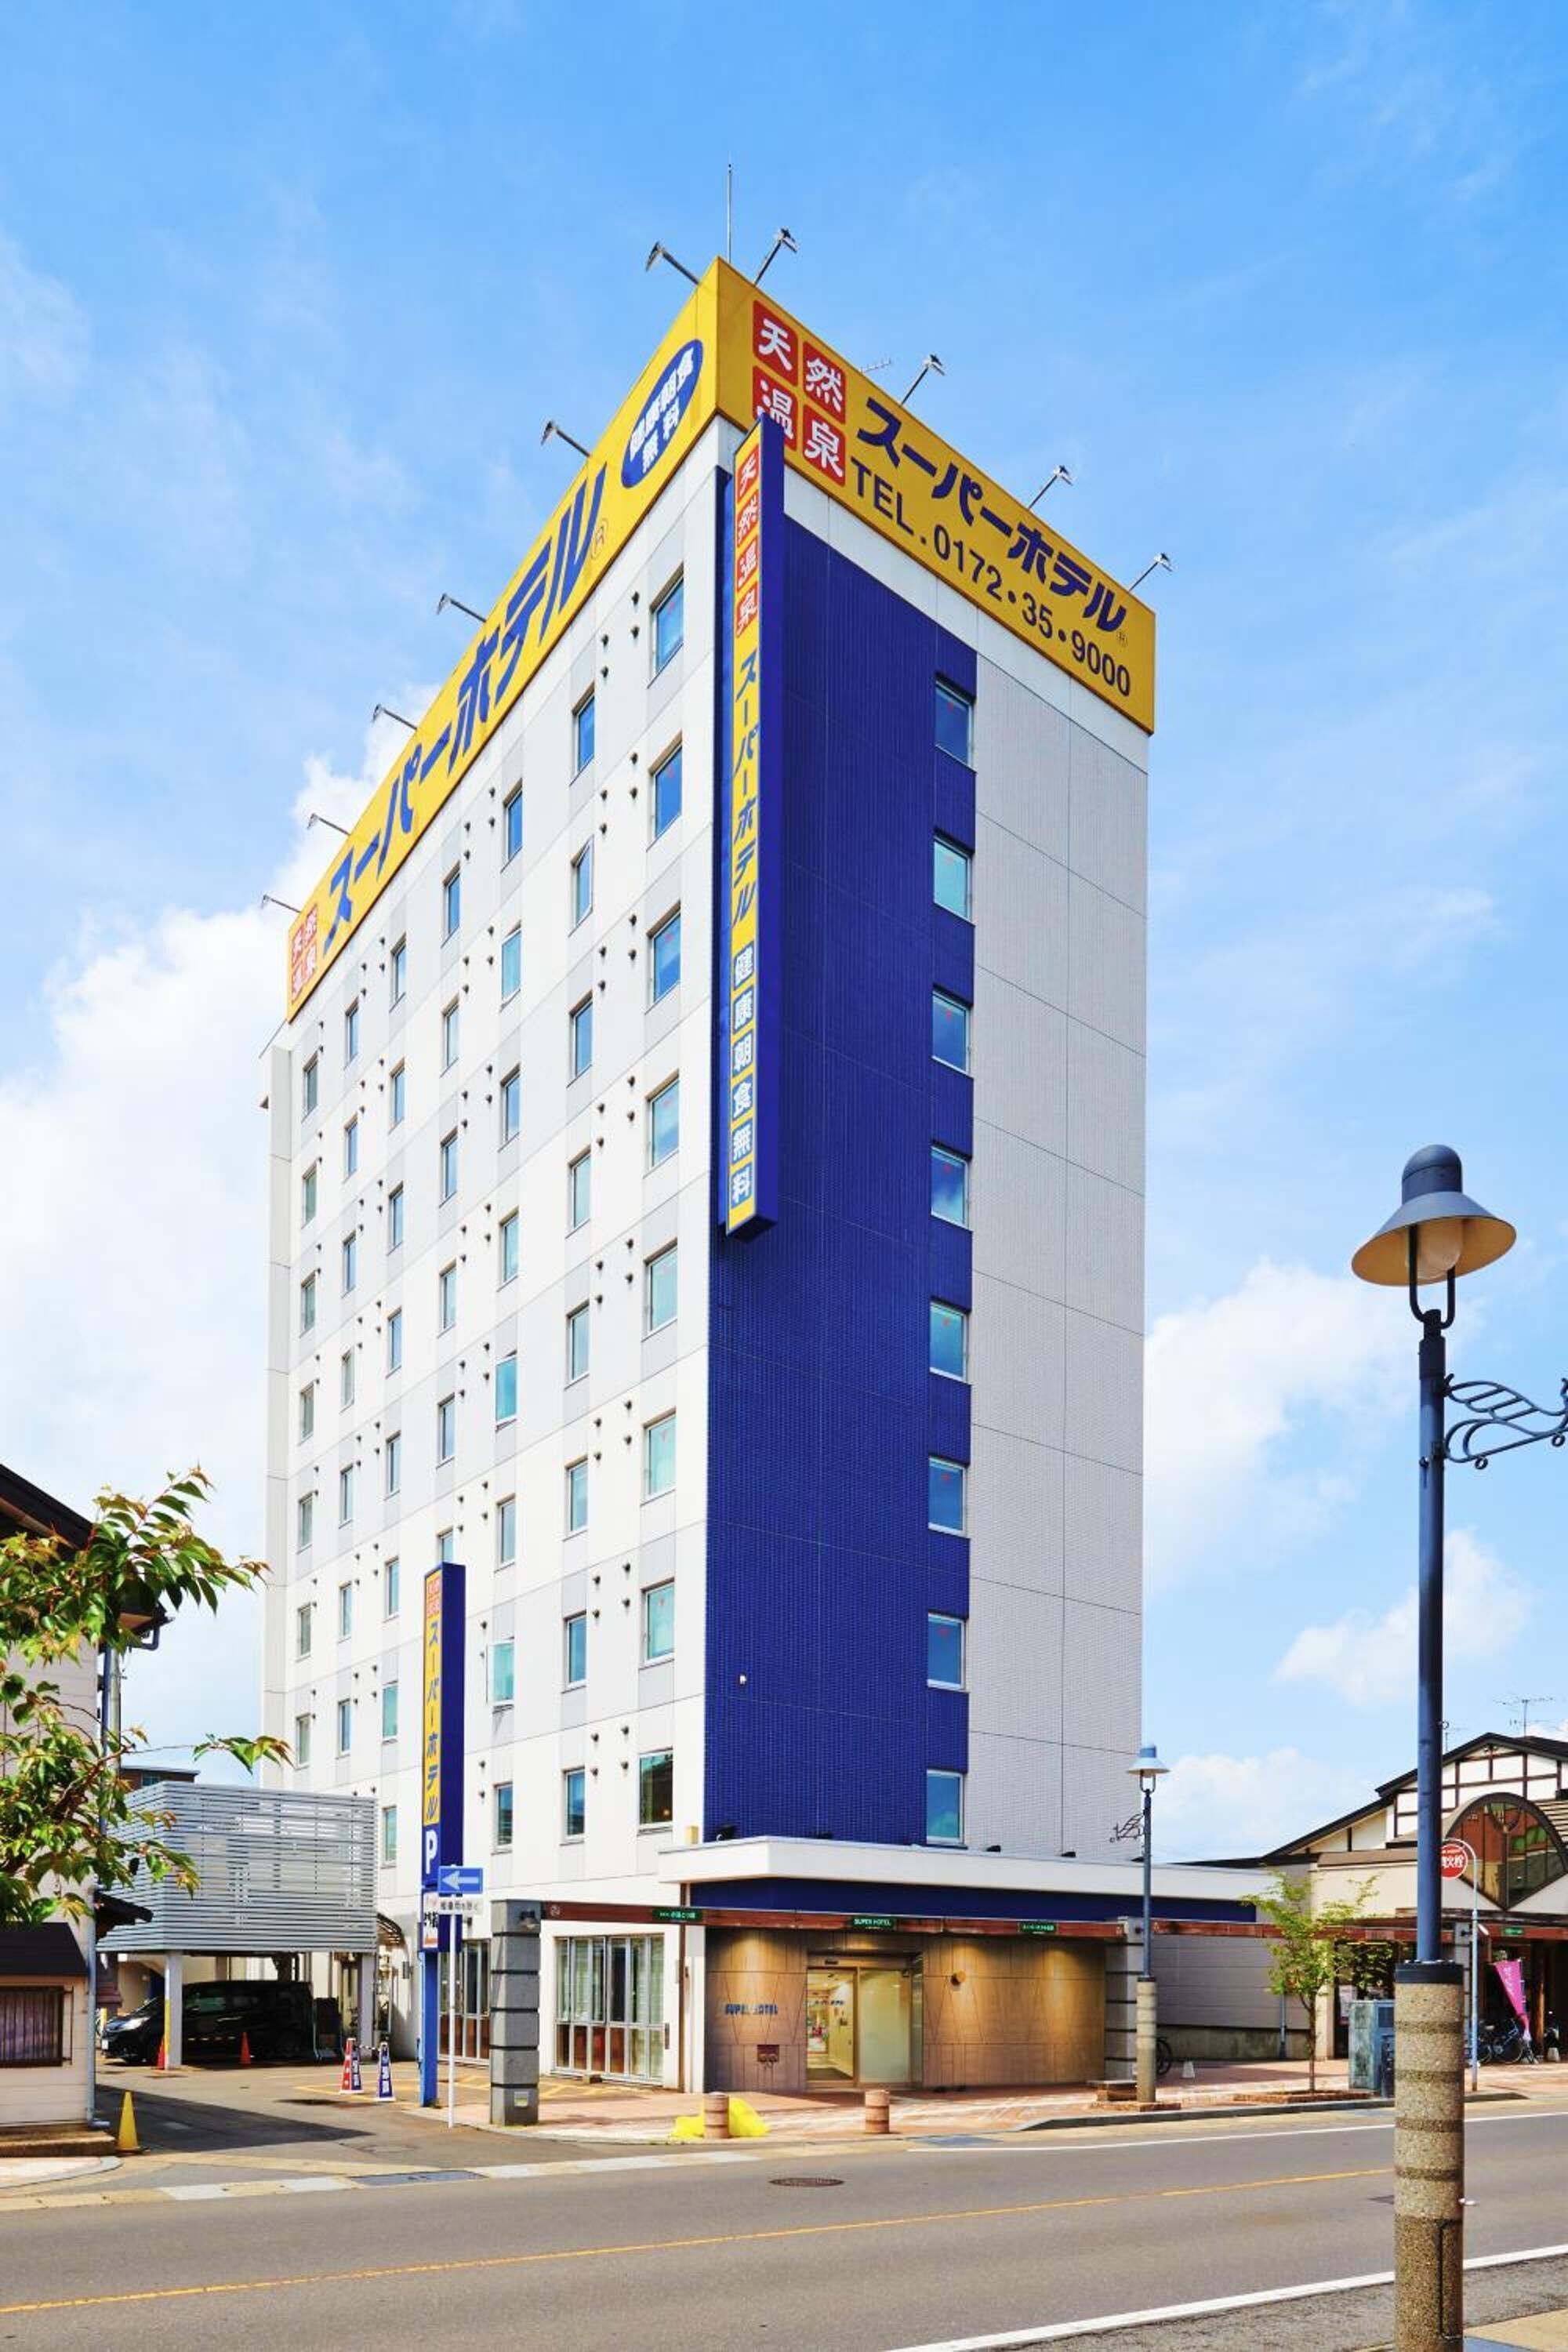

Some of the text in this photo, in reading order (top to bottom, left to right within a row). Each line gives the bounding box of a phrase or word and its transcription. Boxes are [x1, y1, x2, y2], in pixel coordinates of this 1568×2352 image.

[757, 379, 844, 477] 温泉
[758, 318, 843, 412] 天然
[736, 452, 758, 636] 天然温泉
[857, 397, 1127, 632] スーパーホテル
[323, 461, 608, 958] スーパーホテル
[732, 647, 759, 929] スーパーホテル
[732, 945, 753, 1203] 健康朝食無料
[426, 1621, 440, 1820] スーパーホテル
[426, 1829, 437, 1875] P
